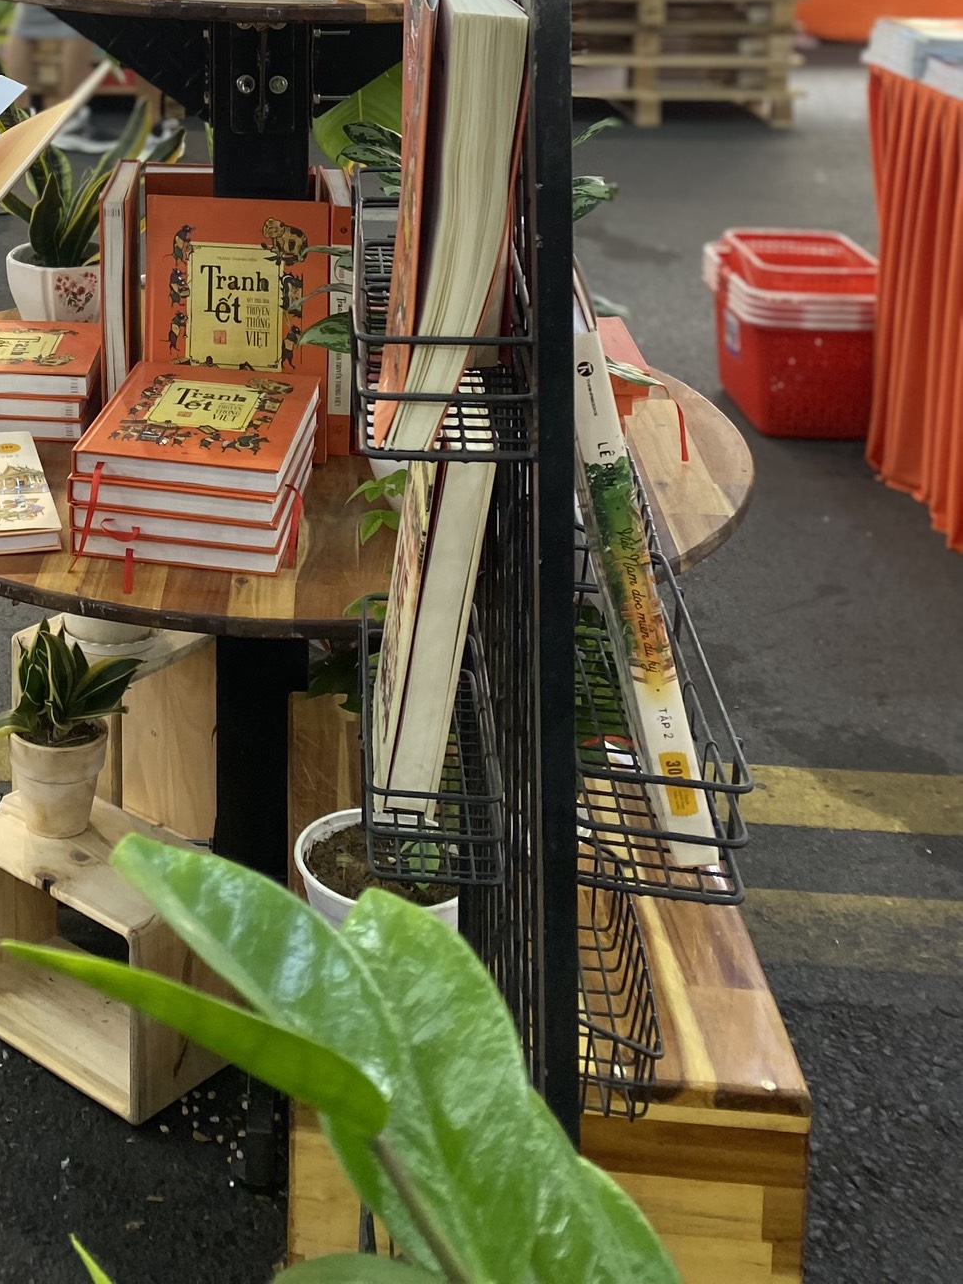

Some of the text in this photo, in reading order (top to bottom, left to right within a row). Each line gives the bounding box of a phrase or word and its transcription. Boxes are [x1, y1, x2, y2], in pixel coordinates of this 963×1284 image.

[200, 264, 270, 313] Tranh
[597, 442, 616, 458] LÊ
[623, 553, 640, 586] Nam
[665, 760, 684, 777] 30
